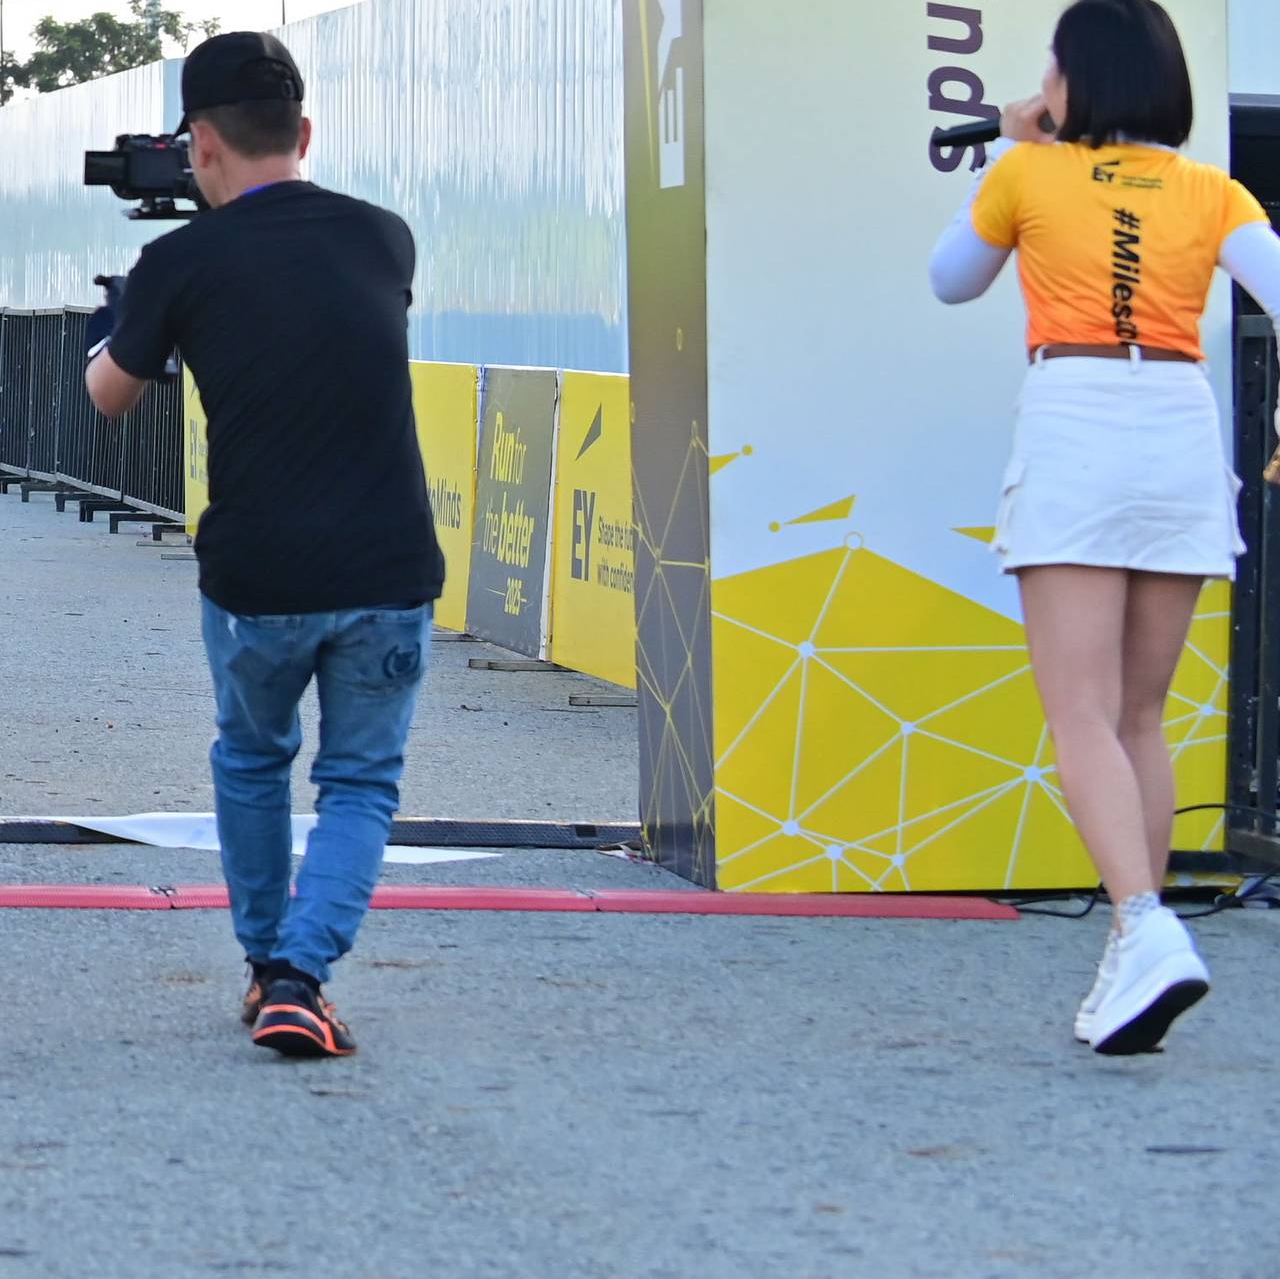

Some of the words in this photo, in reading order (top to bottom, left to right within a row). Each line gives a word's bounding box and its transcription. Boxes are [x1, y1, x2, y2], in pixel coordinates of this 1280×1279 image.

[489, 410, 515, 484] Run
[512, 426, 528, 485] for
[482, 496, 499, 555] the
[496, 489, 536, 569] better
[571, 487, 597, 582] EY
